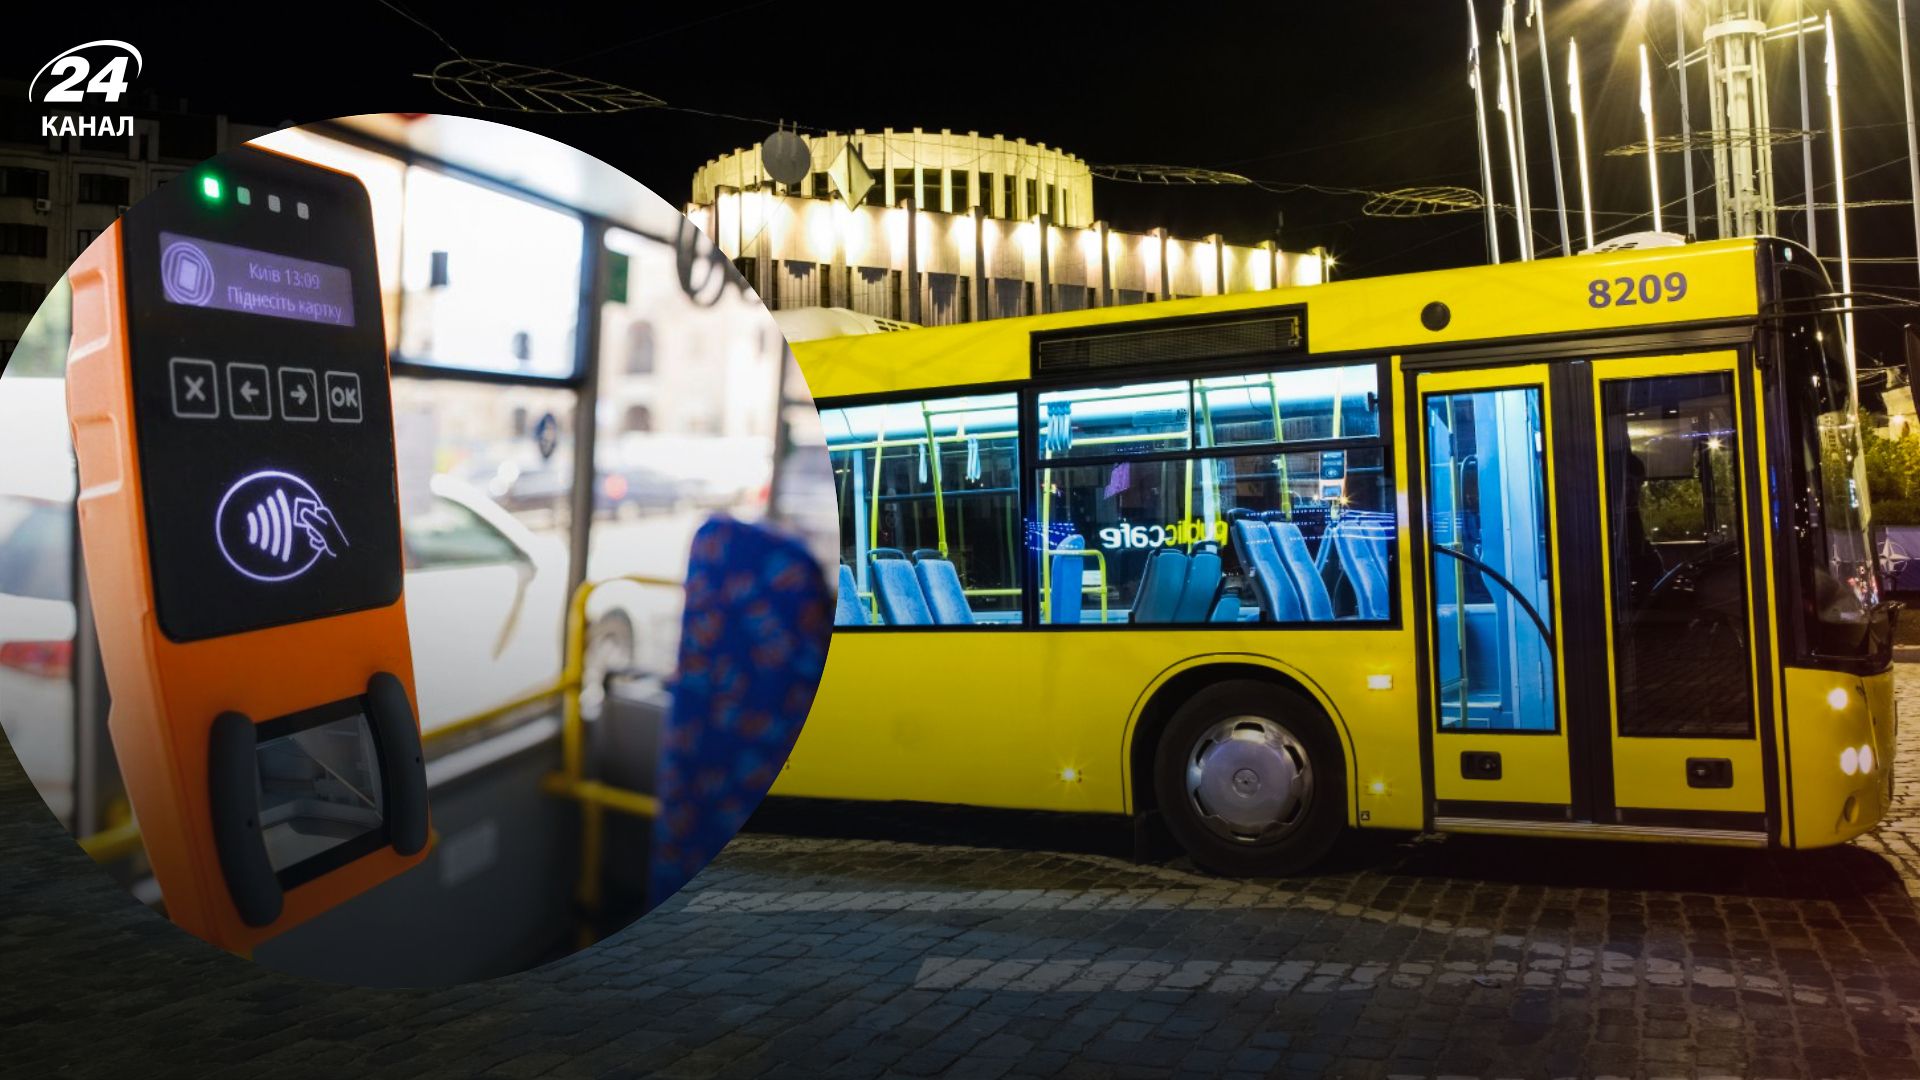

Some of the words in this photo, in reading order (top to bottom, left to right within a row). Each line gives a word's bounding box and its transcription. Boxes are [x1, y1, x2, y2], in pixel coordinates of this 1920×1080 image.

[249, 262, 281, 283] Київ
[286, 269, 321, 290] 13:09
[1588, 271, 1688, 309] 8209
[227, 286, 296, 313] Піднесіть
[299, 301, 343, 323] картку
[331, 386, 358, 407] OK
